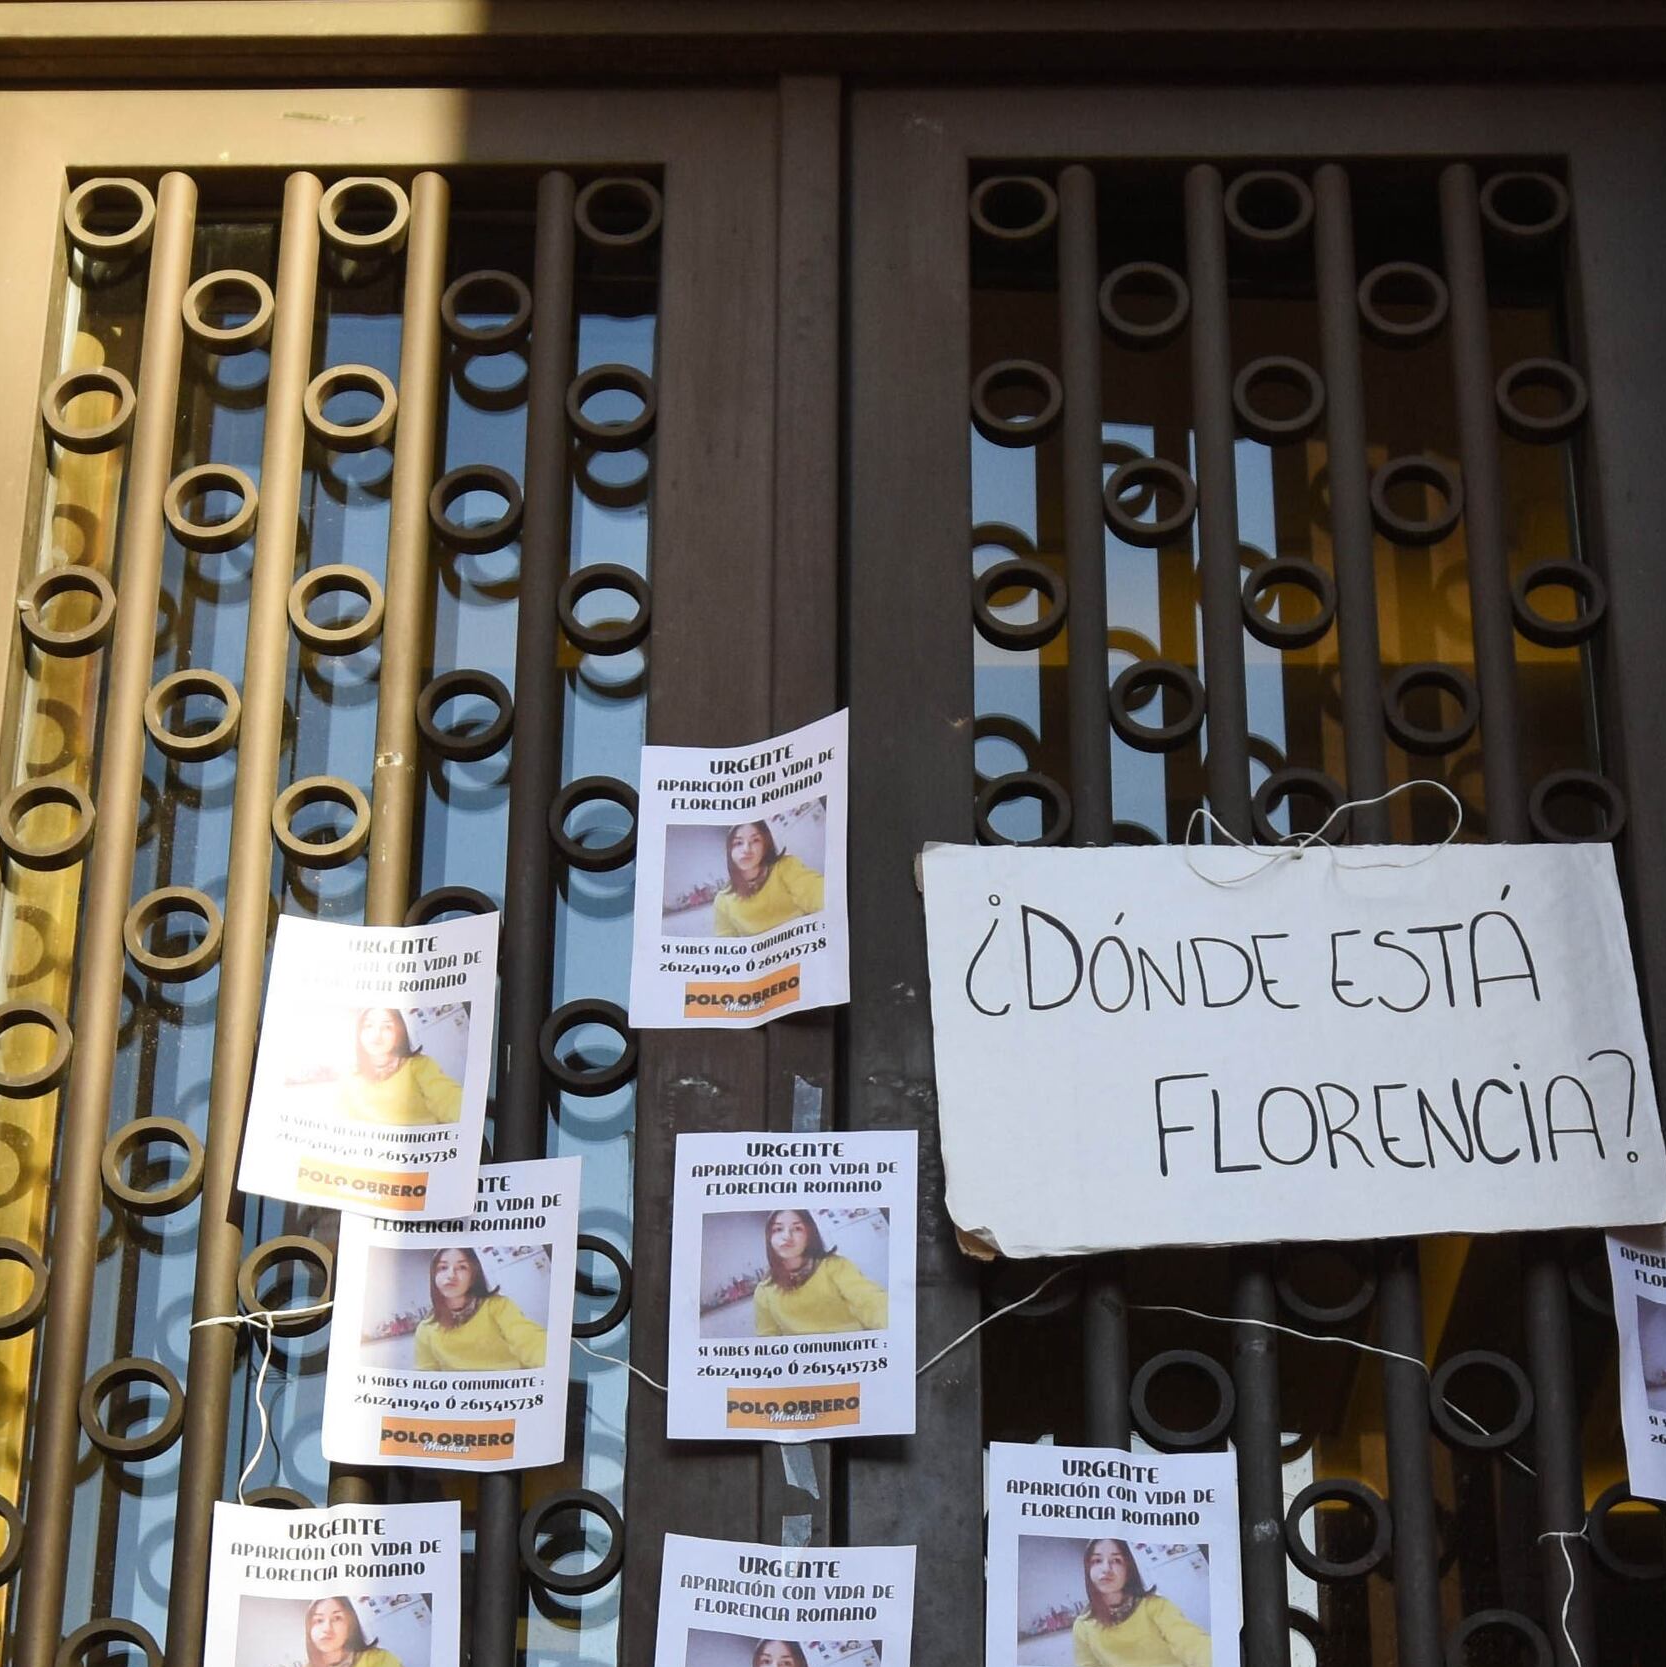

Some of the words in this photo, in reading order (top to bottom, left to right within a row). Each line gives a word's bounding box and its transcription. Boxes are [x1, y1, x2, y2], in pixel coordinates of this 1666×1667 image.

[710, 744, 794, 775] URGENTE
[671, 796, 756, 810] FLORENCIA
[761, 771, 822, 804] ROMANO
[965, 894, 1300, 1016] ¿DÓNDE
[1331, 884, 1540, 1013] ESTÁ
[424, 955, 457, 972] VIDA
[464, 951, 482, 965] DE
[399, 972, 467, 992] ROMANO
[747, 1143, 844, 1157] URGENTE
[706, 1181, 797, 1196] FLORENCIA
[804, 1180, 882, 1193] ROMANO
[496, 1198, 534, 1212] VIDA
[541, 1194, 562, 1208] DE
[471, 1216, 546, 1232] ROMANO
[1062, 1459, 1159, 1484] URGENTE
[1022, 1503, 1115, 1520] FLORENCIA
[1122, 1509, 1200, 1526] ROMANO
[289, 1519, 386, 1540] URGENTE
[245, 1565, 337, 1582] FLORENCIA
[345, 1562, 425, 1578] ROMANO
[739, 1556, 840, 1578] URGENTE
[695, 1598, 789, 1621] FLORENCIA
[796, 1606, 877, 1622] ROMANO
